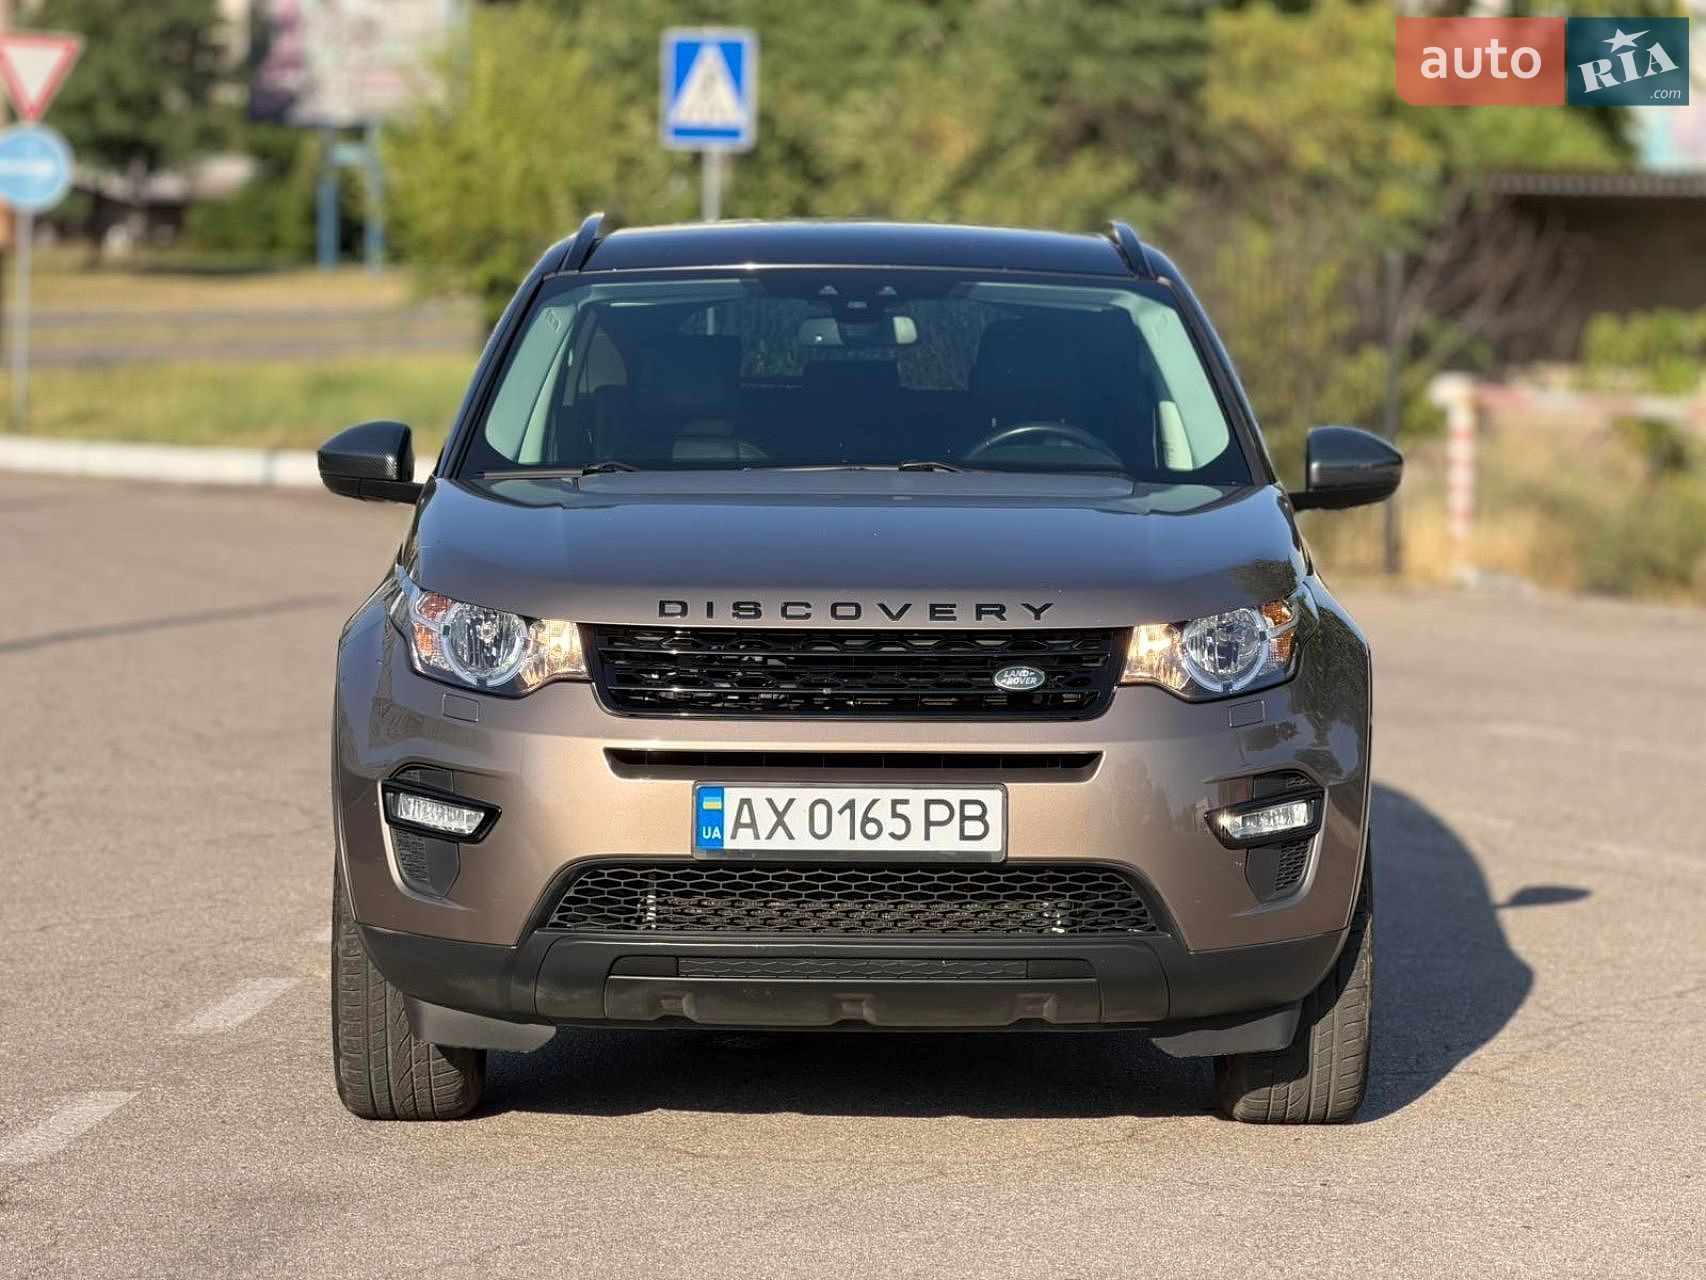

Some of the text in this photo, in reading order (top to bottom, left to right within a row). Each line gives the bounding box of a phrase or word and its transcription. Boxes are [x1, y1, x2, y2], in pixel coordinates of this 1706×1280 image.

[658, 600, 1054, 621] DISCOVERY
[730, 797, 990, 841] AX 0165 PB
[702, 826, 722, 840] UA
